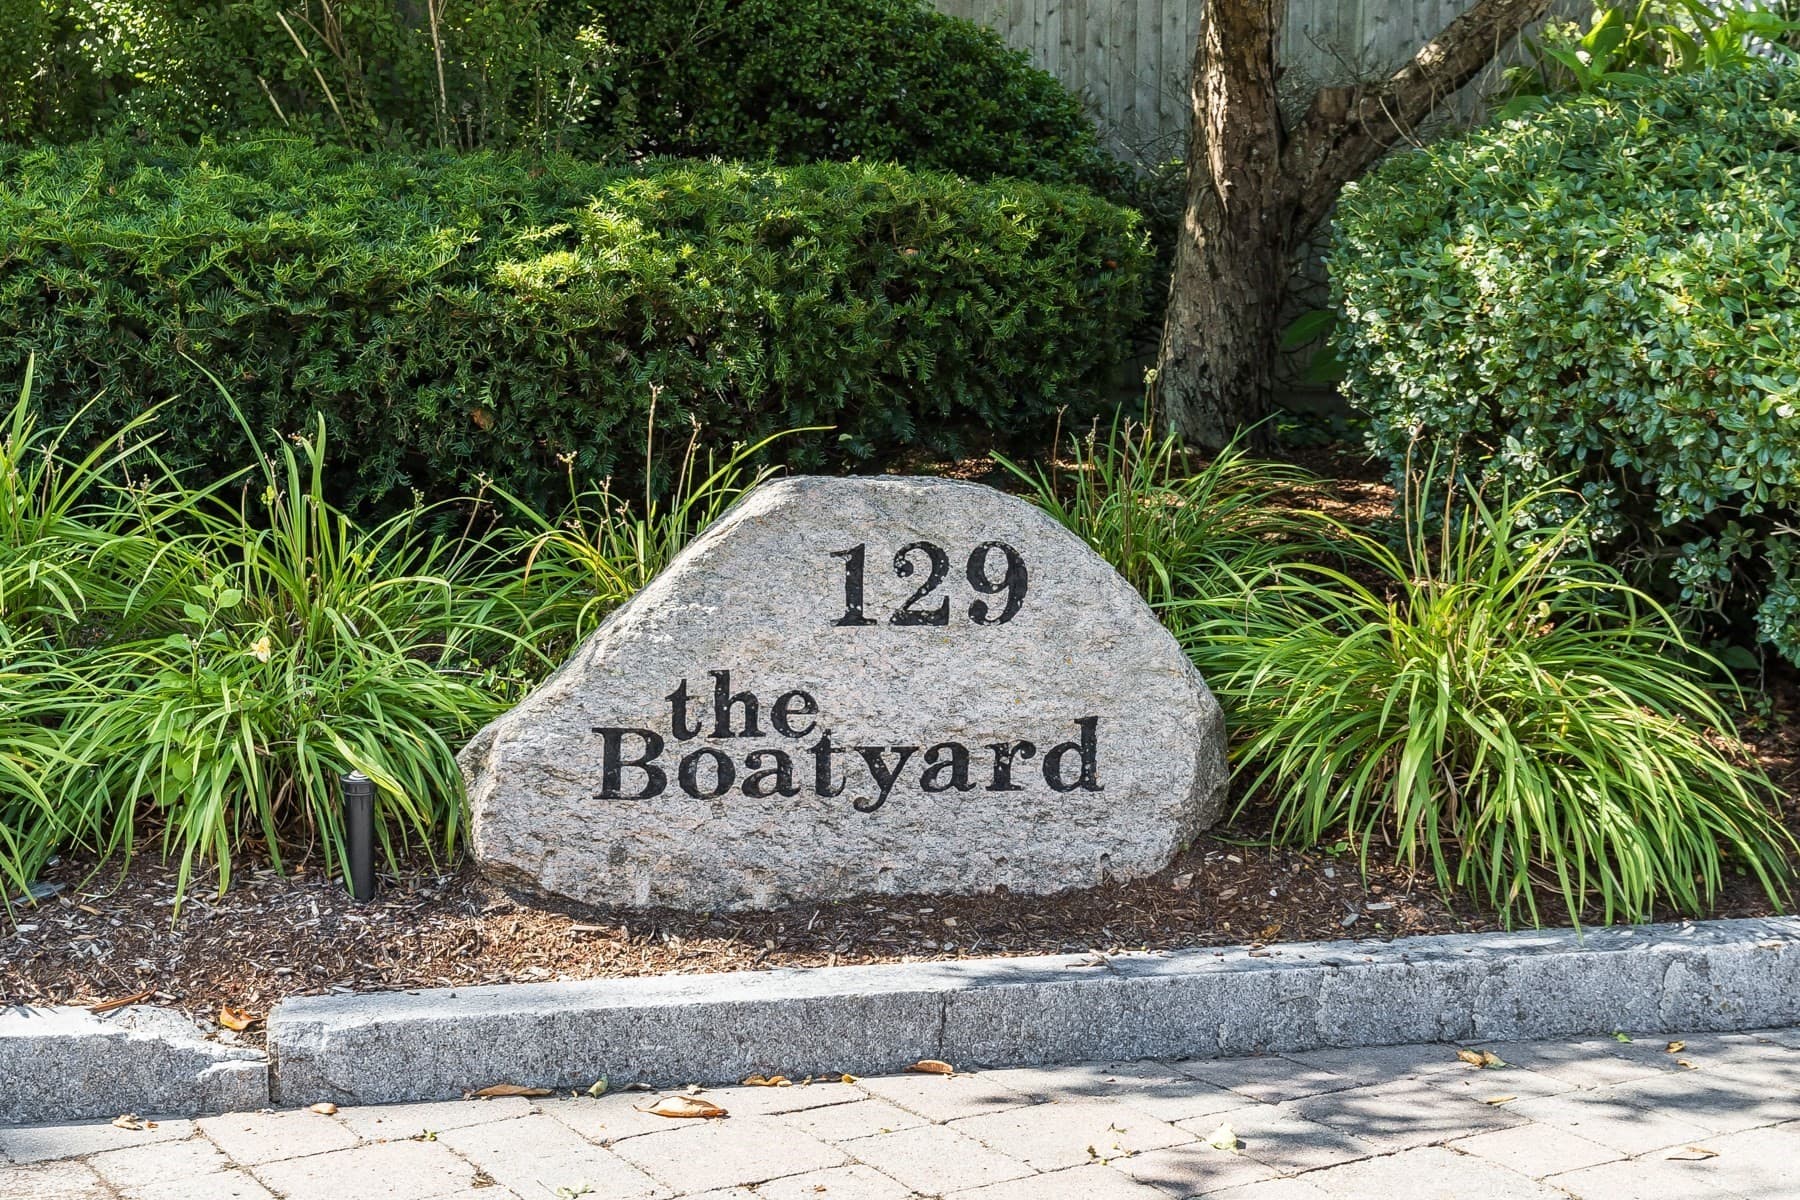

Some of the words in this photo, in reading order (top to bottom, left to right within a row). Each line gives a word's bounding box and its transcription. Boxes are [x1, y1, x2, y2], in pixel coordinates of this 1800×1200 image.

[829, 540, 1029, 627] 129
[664, 669, 819, 741] the
[591, 715, 1105, 814] Boatyard
